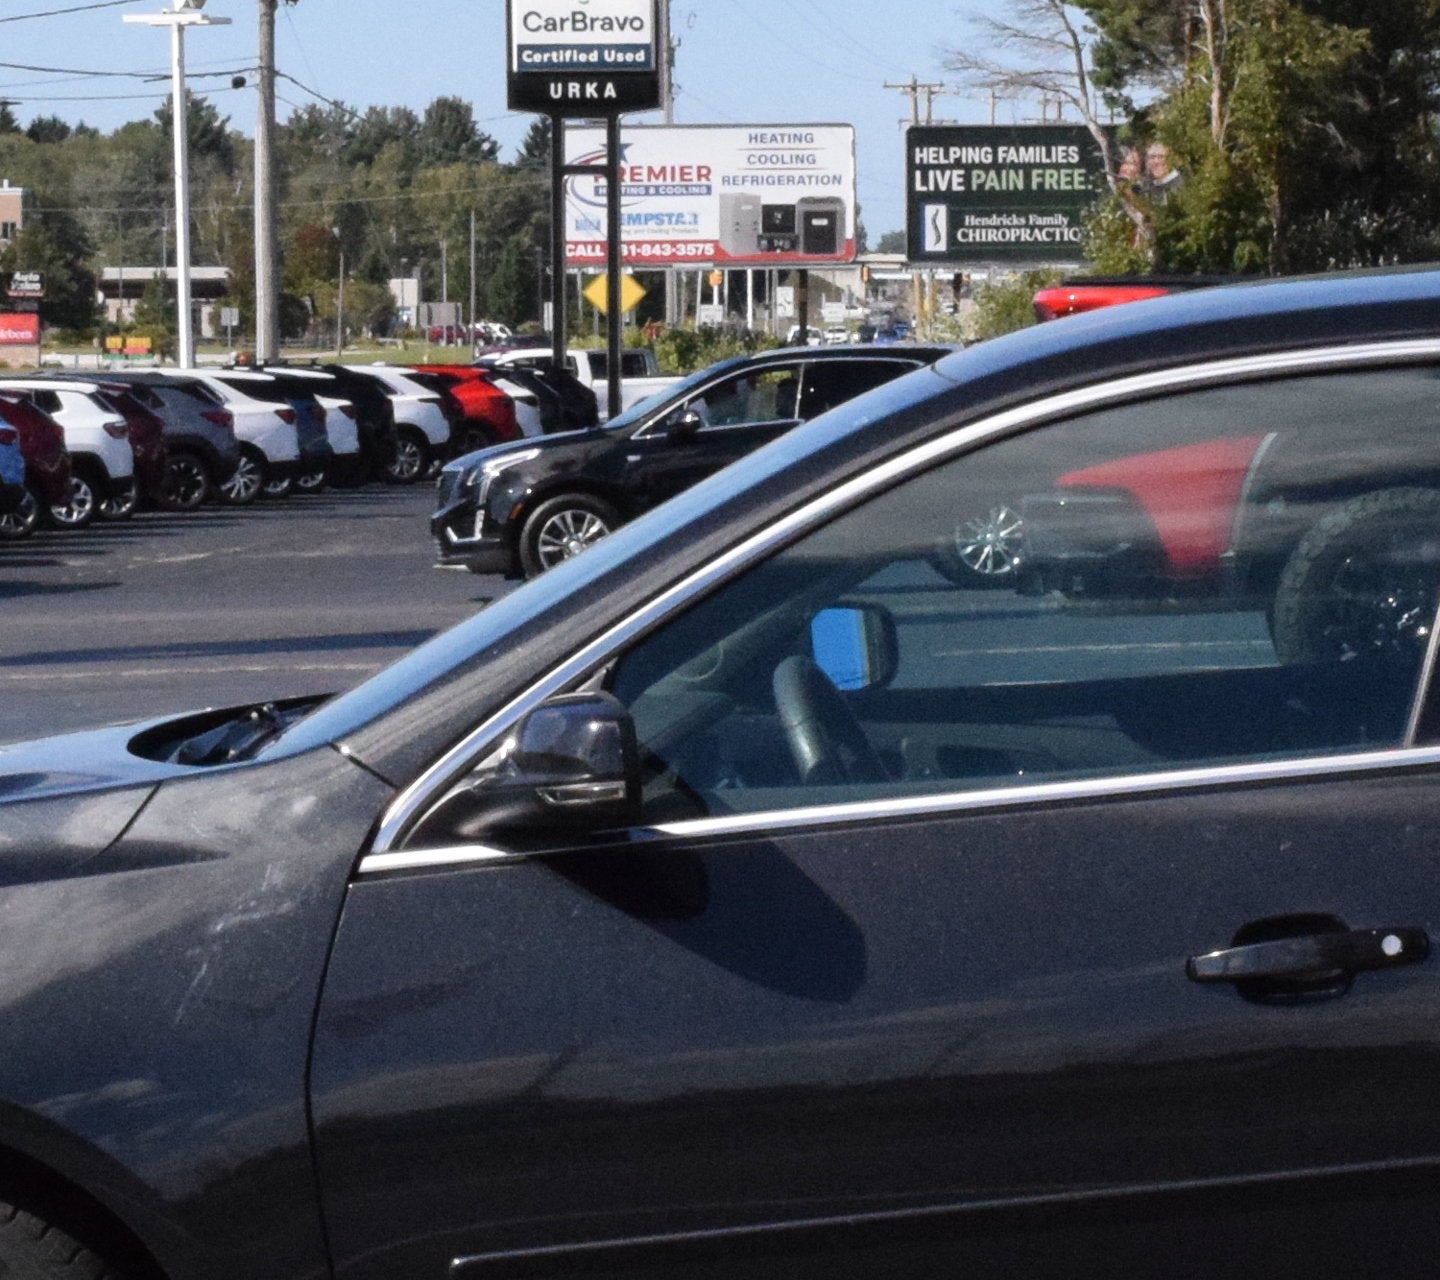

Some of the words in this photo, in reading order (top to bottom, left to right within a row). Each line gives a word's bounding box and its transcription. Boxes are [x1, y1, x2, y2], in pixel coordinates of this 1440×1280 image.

[523, 11, 644, 32] CarBravo
[522, 50, 599, 63] Certified
[603, 49, 646, 62] Used
[549, 82, 617, 99] URKA
[748, 132, 815, 144] HEATING
[747, 153, 817, 165] COOLING
[915, 147, 993, 164] HELPING
[998, 146, 1079, 163] FAMILIES
[721, 174, 842, 187] REFRIGERATION
[915, 170, 965, 192] LIVE
[971, 169, 1024, 191] PAIN
[1031, 169, 1093, 191] FREE.
[598, 186, 645, 195] HTING
[659, 185, 708, 194] COOLING
[964, 214, 1026, 226] Hendricks
[1028, 214, 1069, 228] Family
[565, 245, 605, 257] CALL
